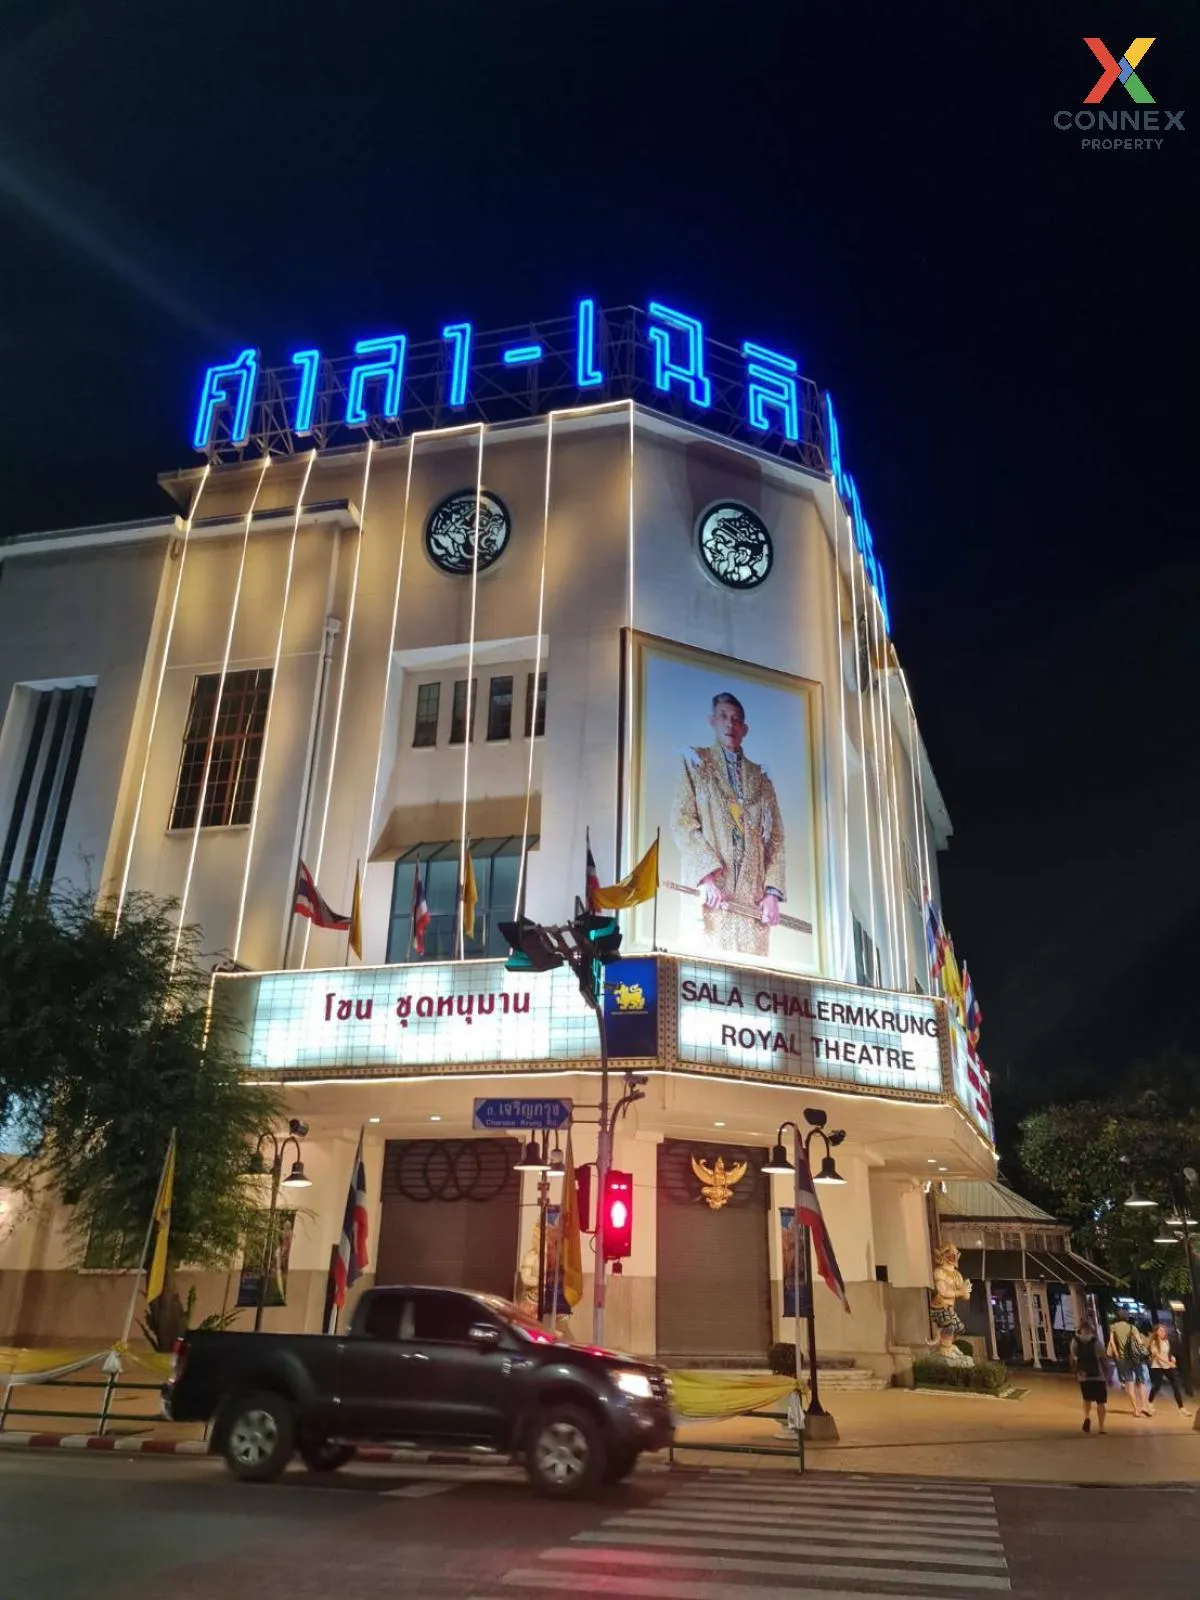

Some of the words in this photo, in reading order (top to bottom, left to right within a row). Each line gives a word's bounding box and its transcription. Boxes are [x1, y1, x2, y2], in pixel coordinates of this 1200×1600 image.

[324, 992, 374, 1022] โขน
[396, 991, 531, 1028] ชุดหนุมาน
[681, 980, 744, 1009] SALA
[754, 990, 939, 1038] CHALERMKRUNG
[720, 1023, 801, 1055] ROYAL
[810, 1035, 917, 1071] THEATRE
